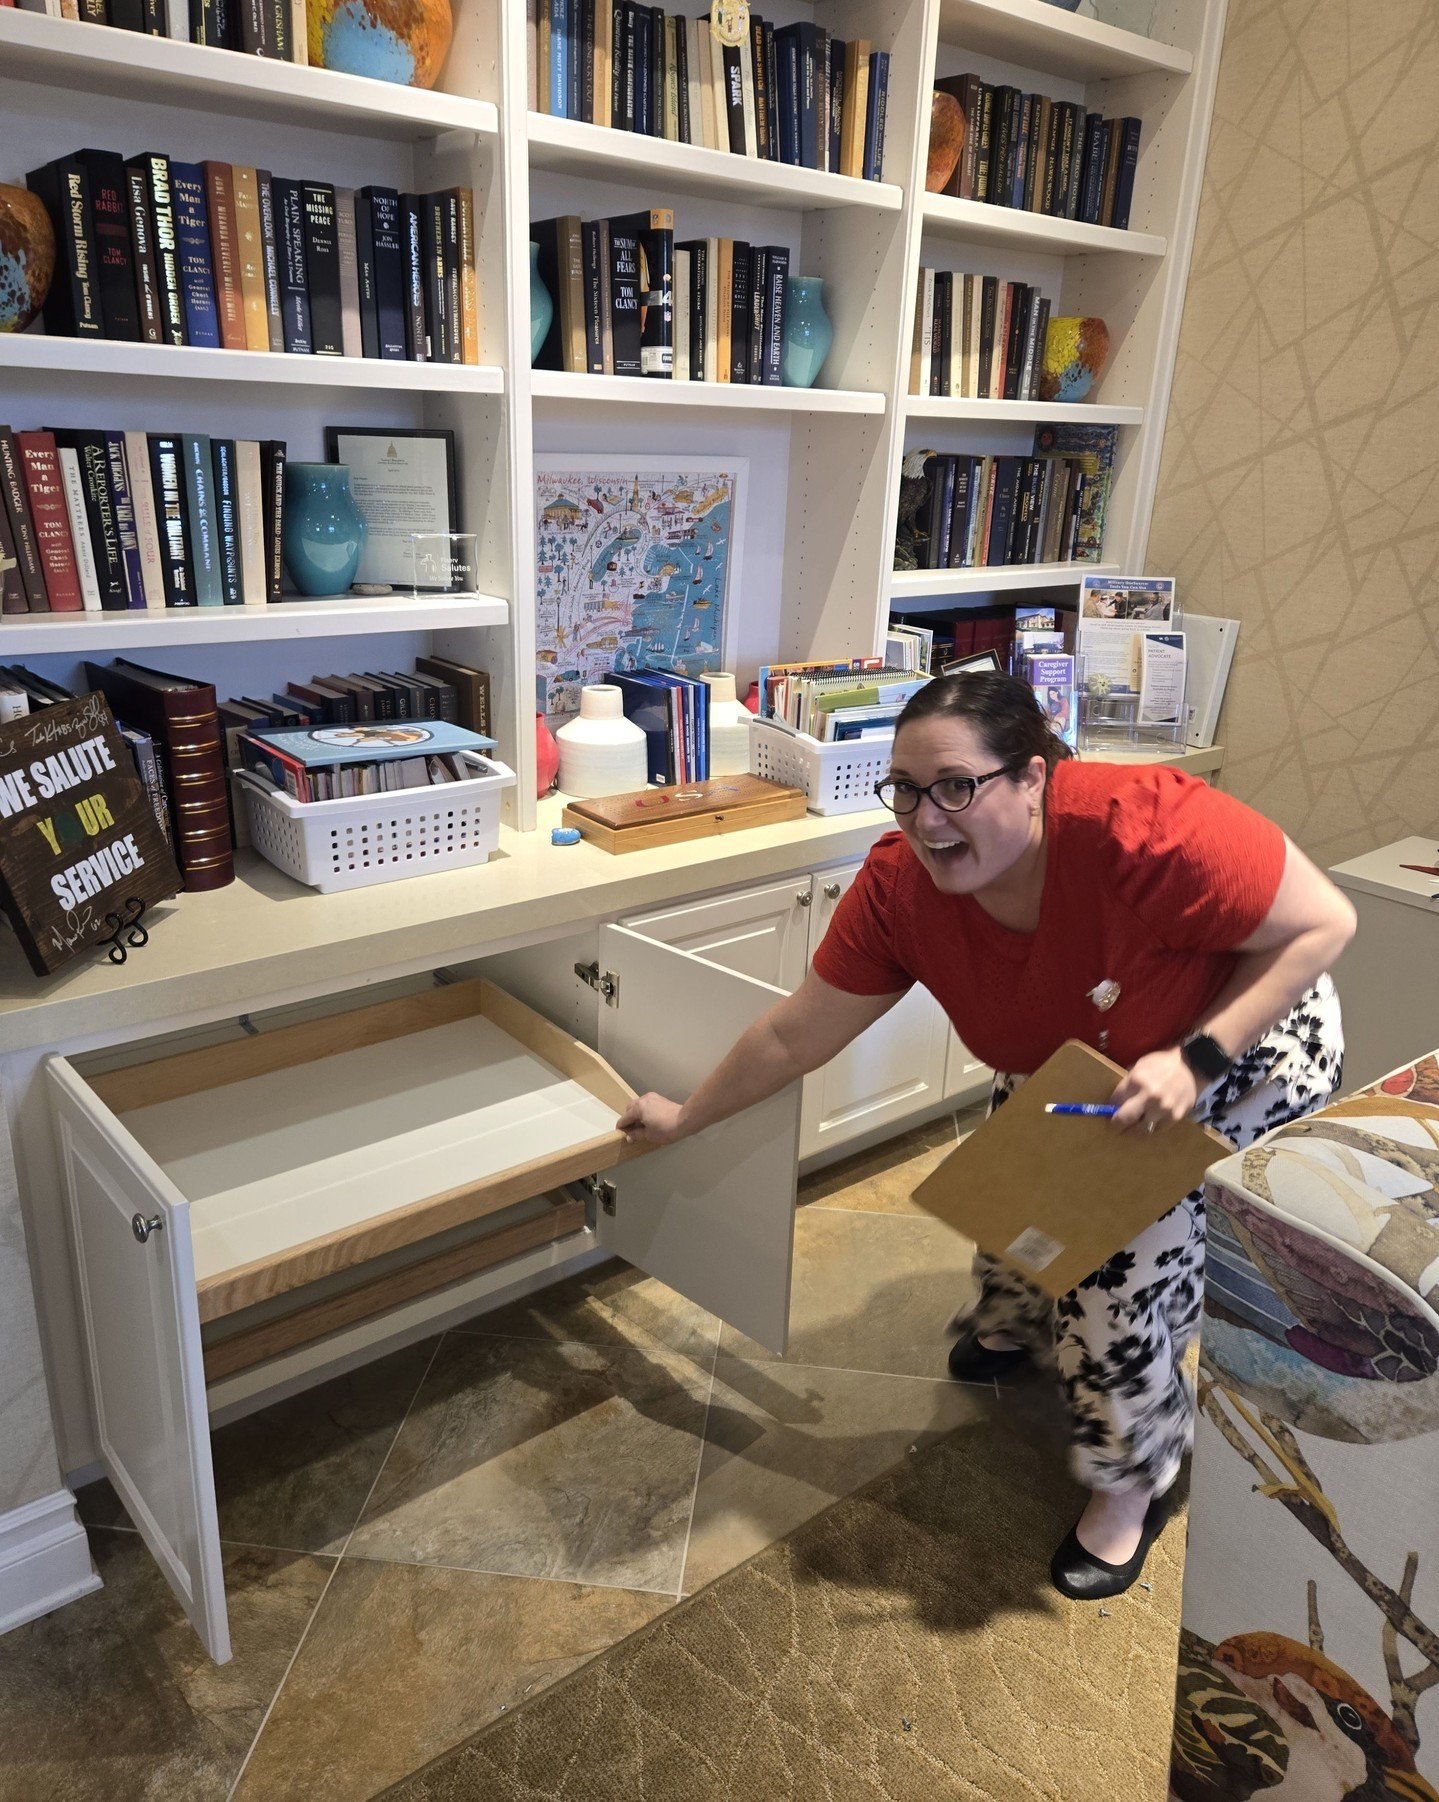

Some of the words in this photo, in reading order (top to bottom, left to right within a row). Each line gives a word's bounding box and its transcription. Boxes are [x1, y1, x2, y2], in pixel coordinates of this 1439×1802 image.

[730, 65, 742, 107] SPARK
[68, 173, 82, 199] Red
[131, 175, 142, 203] Lisa
[151, 157, 171, 203] BRAD
[175, 179, 202, 192] Every
[261, 183, 270, 198] THE
[101, 188, 117, 200] RED
[179, 192, 201, 204] Man
[312, 193, 326, 203] THE
[373, 197, 397, 207] NORTH
[71, 200, 84, 238] Storm
[95, 200, 125, 214] RABBIT
[262, 199, 273, 238] OVERLOOK
[289, 190, 300, 225] PLAIN
[305, 203, 334, 215] MISSING
[377, 212, 395, 221] HOPE
[134, 206, 147, 254] Genova
[156, 205, 176, 251] THOR
[178, 215, 206, 229] Tiger
[310, 215, 331, 226] PEACE
[434, 206, 443, 244] BROTHERS
[409, 211, 419, 266] AMERICAN
[436, 245, 443, 254] IN
[74, 239, 90, 280] Rising
[103, 256, 127, 266] CLANCY
[107, 247, 121, 257] TOM
[188, 256, 205, 265] TOM
[266, 245, 277, 279] MICHAEL
[292, 228, 305, 284] SPEAKING
[620, 251, 633, 261] ALL
[163, 252, 178, 290] HIDDEN
[182, 265, 210, 275] CLANCY
[436, 255, 445, 279] ARMS
[616, 261, 636, 273] FEARS
[411, 266, 422, 307] HEROES
[620, 286, 634, 297] TOM
[775, 274, 783, 294] RAISE
[167, 291, 181, 325] ORDER
[269, 279, 280, 317] CONNELLY
[615, 298, 638, 309] CLANCY
[774, 295, 783, 323] HEAVEN
[1032, 295, 1040, 317] MAN
[753, 291, 761, 331] LEADERSHIFT
[415, 315, 423, 345] NORTH
[773, 324, 782, 341] AND
[772, 342, 781, 365] EARTH
[1026, 338, 1036, 371] MIDDLE
[1, 439, 16, 479] HUNTING
[25, 449, 54, 460] Every
[84, 445, 93, 469] Walter
[90, 444, 104, 457] A
[31, 462, 54, 471] Man
[68, 466, 77, 485] THE
[160, 453, 179, 490] WOMEN
[30, 484, 60, 494] Tiger
[87, 470, 98, 502] Cronkite
[537, 474, 583, 485] Milwaukee,
[587, 474, 628, 485] Wisconsin
[9, 480, 24, 513] BADGER
[93, 459, 116, 536] REPORTER'S
[164, 490, 179, 502] IN
[72, 488, 86, 537] MAYTREES
[165, 502, 180, 519] THE
[222, 500, 234, 533] FINDING
[20, 524, 29, 541] TONY
[166, 519, 186, 561] MILITARY
[23, 541, 36, 574] HILLERMAN
[106, 538, 119, 564] LIFE
[441, 563, 471, 572] Salutes
[1038, 661, 1069, 669] Caregiver
[0, 768, 38, 819] WE
[30, 734, 117, 799] SALUTE
[50, 833, 145, 911] SERVICE
